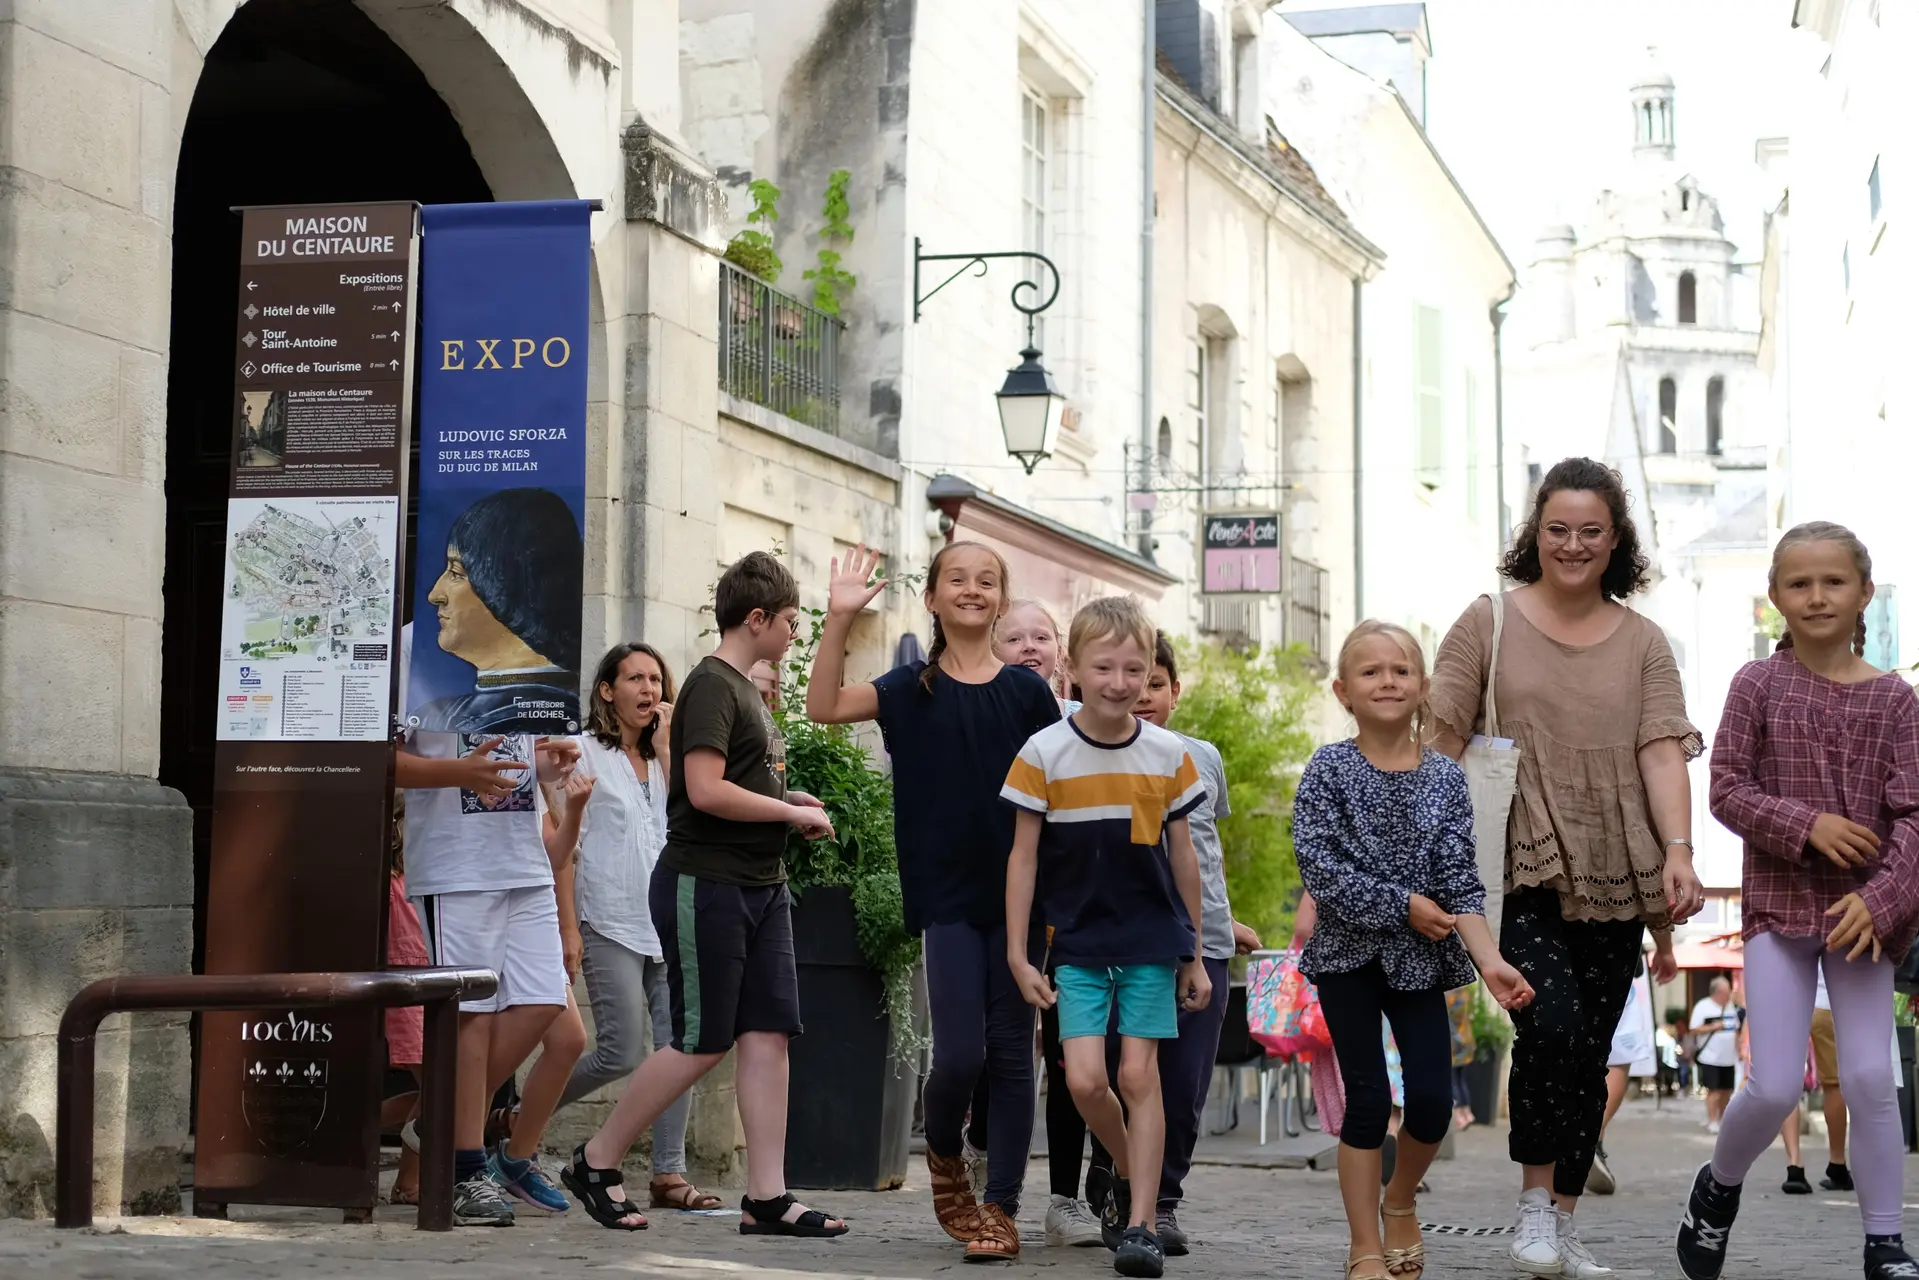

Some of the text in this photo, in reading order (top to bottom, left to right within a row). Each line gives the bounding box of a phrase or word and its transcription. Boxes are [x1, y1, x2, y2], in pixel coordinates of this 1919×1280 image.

[286, 216, 367, 235] MAISON
[257, 235, 394, 258] DU CENTAURE
[340, 273, 403, 286] Expositions
[263, 304, 335, 317] Hôtel de ville
[262, 329, 286, 339] Tour
[261, 338, 337, 350] Saint-Antoine
[440, 337, 571, 370] EXPO
[261, 361, 361, 374] Office de Tourisme
[439, 429, 567, 443] LUDOVIC SFORZA
[439, 449, 530, 460] SUR LES TRACES
[439, 461, 538, 472] DU DUC DE MILAN
